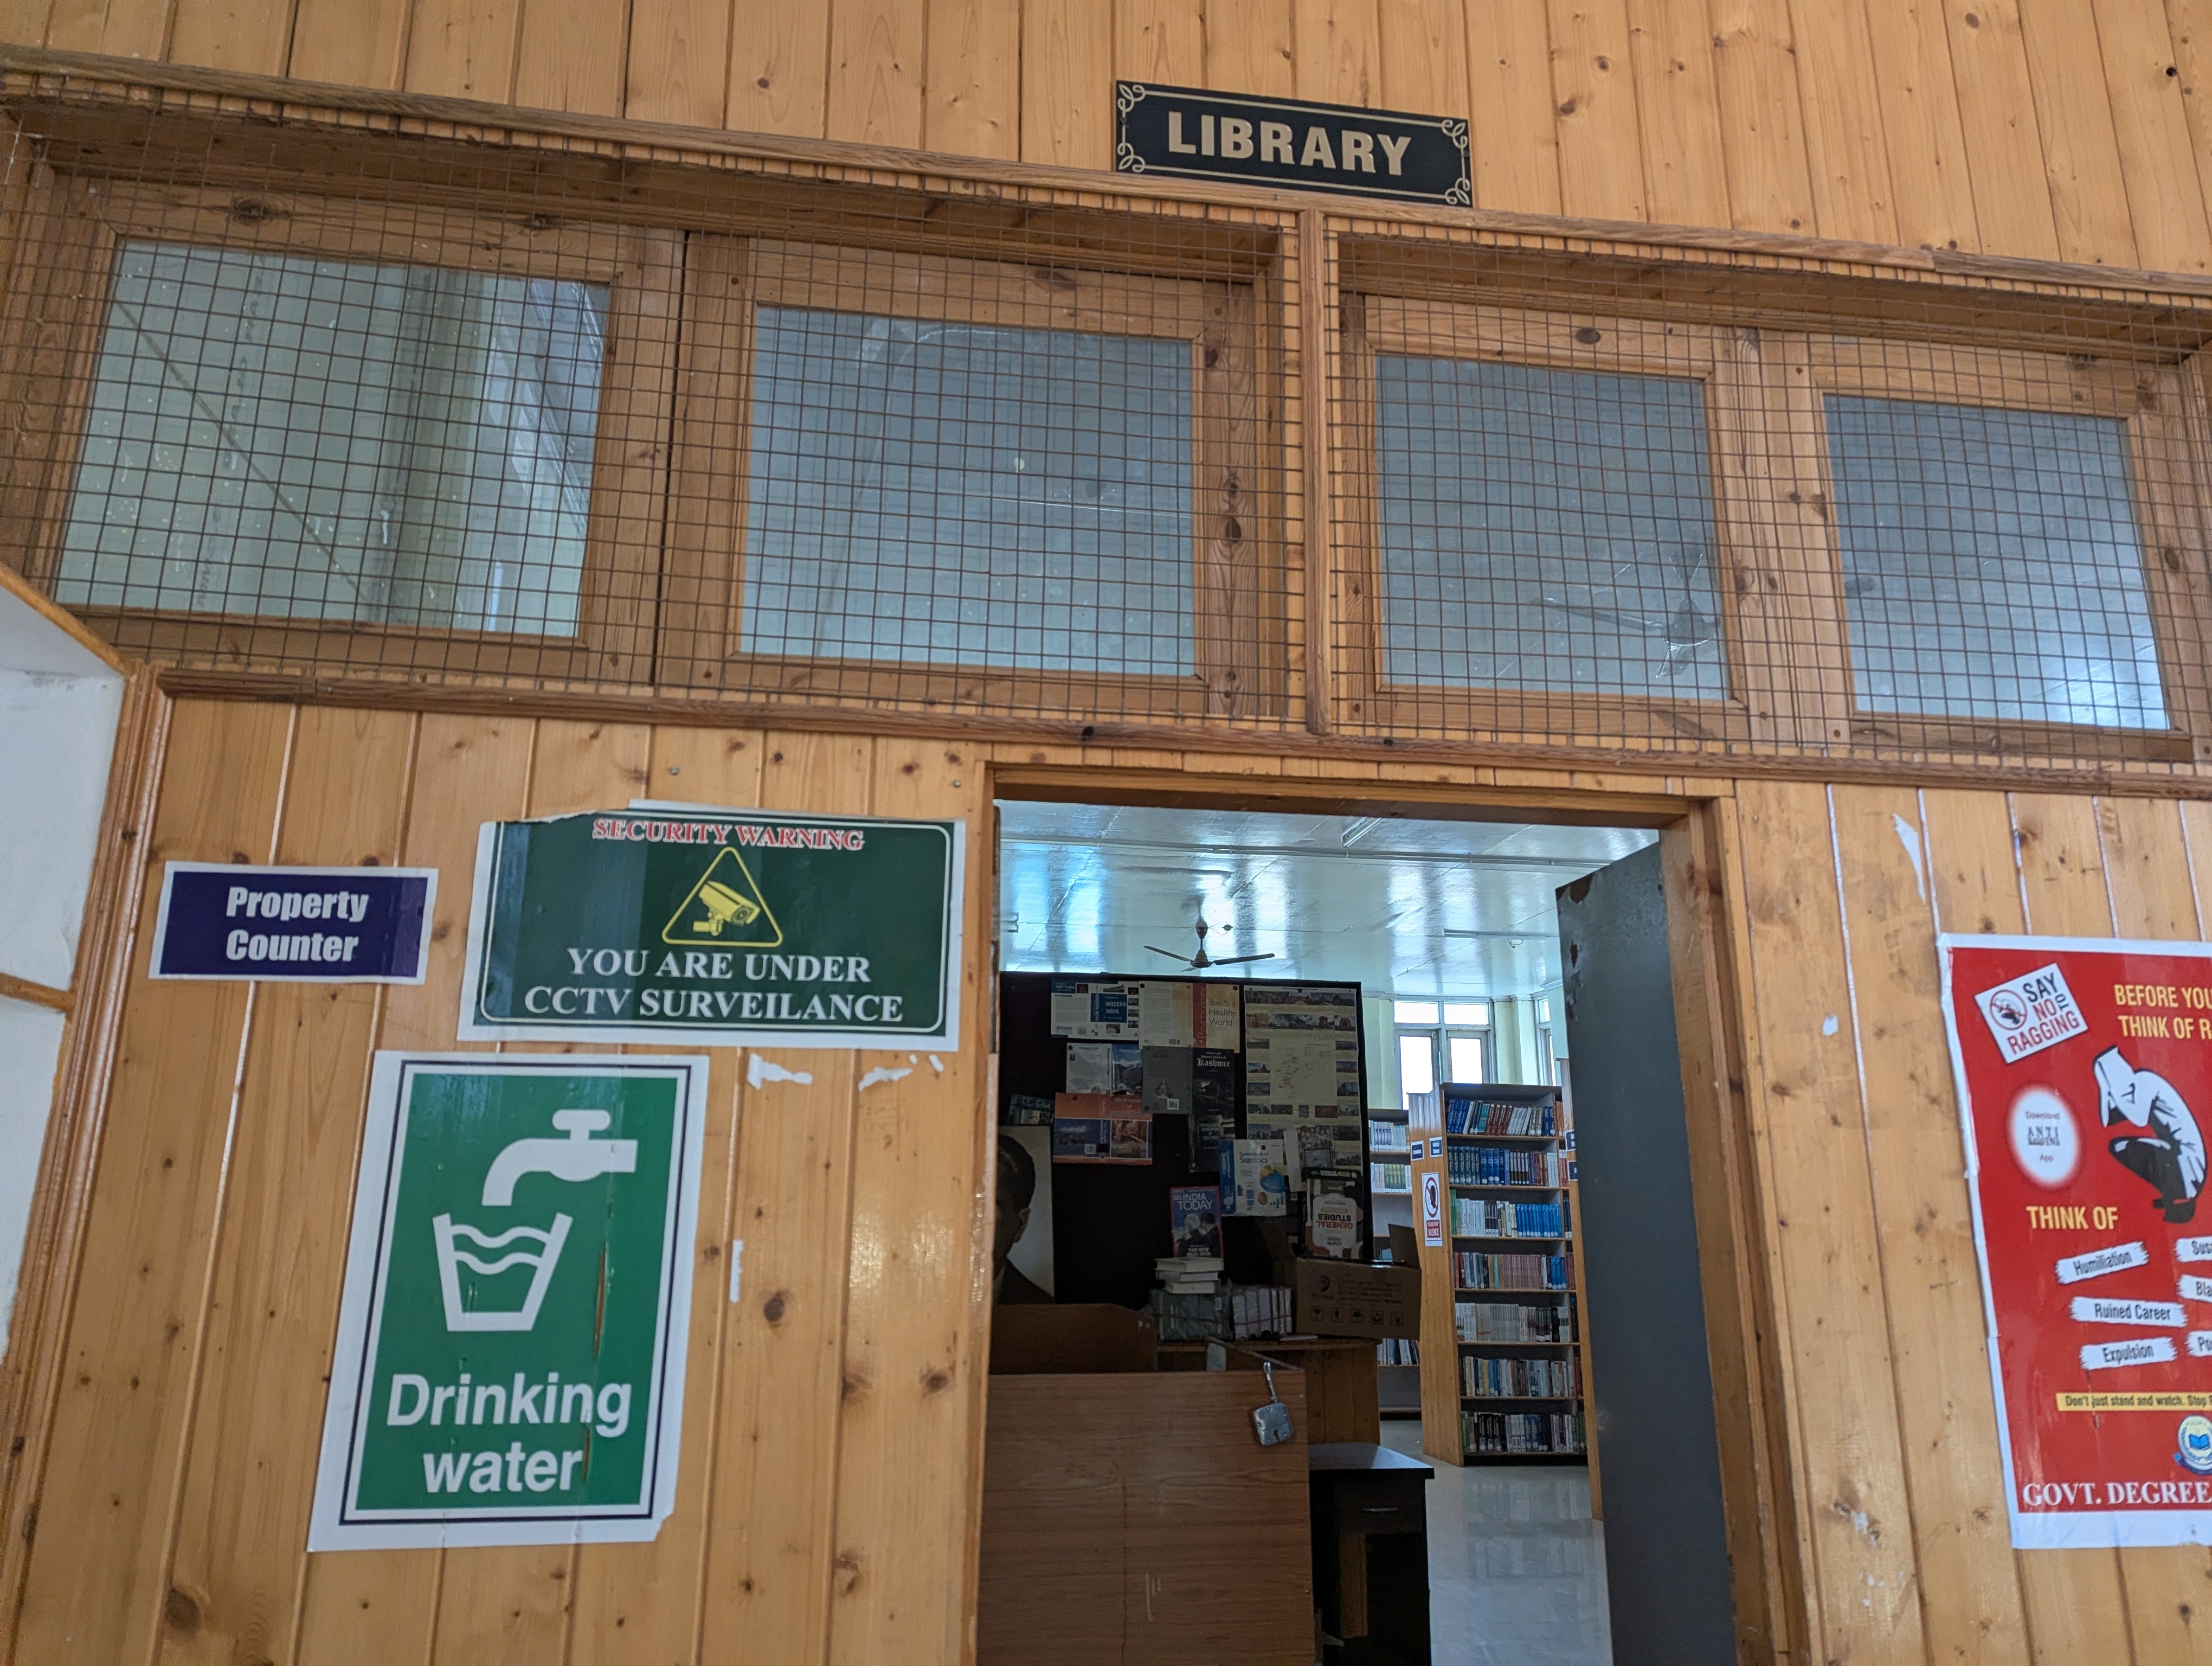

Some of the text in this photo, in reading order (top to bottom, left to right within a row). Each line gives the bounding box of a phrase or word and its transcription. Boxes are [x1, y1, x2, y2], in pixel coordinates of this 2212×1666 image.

[1168, 111, 1411, 176] LIBRARY
[592, 817, 865, 850] SECURITY WARNING
[226, 886, 369, 922] Property
[226, 929, 359, 962] Counter
[568, 947, 871, 983] YOU ARE UNDER
[2023, 972, 2058, 1003] SAY
[2114, 983, 2179, 1008] BEFORE
[524, 986, 903, 1022] CCTV SURVEILANCE
[1208, 998, 1230, 1007] Builds
[1208, 1008, 1237, 1017] Healthy
[2033, 998, 2057, 1021] NO
[2055, 994, 2069, 1011] TO
[1208, 1018, 1233, 1026] World
[2007, 1010, 2080, 1055] RAGGING
[2117, 1015, 2170, 1039] THINK
[2172, 1016, 2195, 1040] OF
[1197, 1058, 1231, 1068] Kashmir
[2025, 1110, 2060, 1120] Download
[2028, 1126, 2059, 1138] ANTI
[1239, 1156, 1269, 1164] Statistics
[1177, 1200, 1213, 1211] TODAY
[1182, 1193, 1207, 1202] INDIA
[1315, 1220, 1354, 1229] GENERAL
[1317, 1213, 1352, 1222] STUDIES
[2026, 1206, 2119, 1229] THINK OF
[2073, 1251, 2133, 1276] Humiliation
[2094, 1303, 2171, 1321] Ruined Career
[2102, 1344, 2155, 1364] Expulsion
[386, 1372, 632, 1438] Drinking
[2065, 1395, 2088, 1406] Don't
[2092, 1395, 2108, 1408] just
[2111, 1395, 2134, 1406] stand
[2137, 1395, 2154, 1406] and
[2156, 1395, 2185, 1406] watch.
[2187, 1395, 2207, 1408] Stop
[422, 1442, 583, 1493] water
[2022, 1481, 2212, 1506] GOVT. DEGREE
